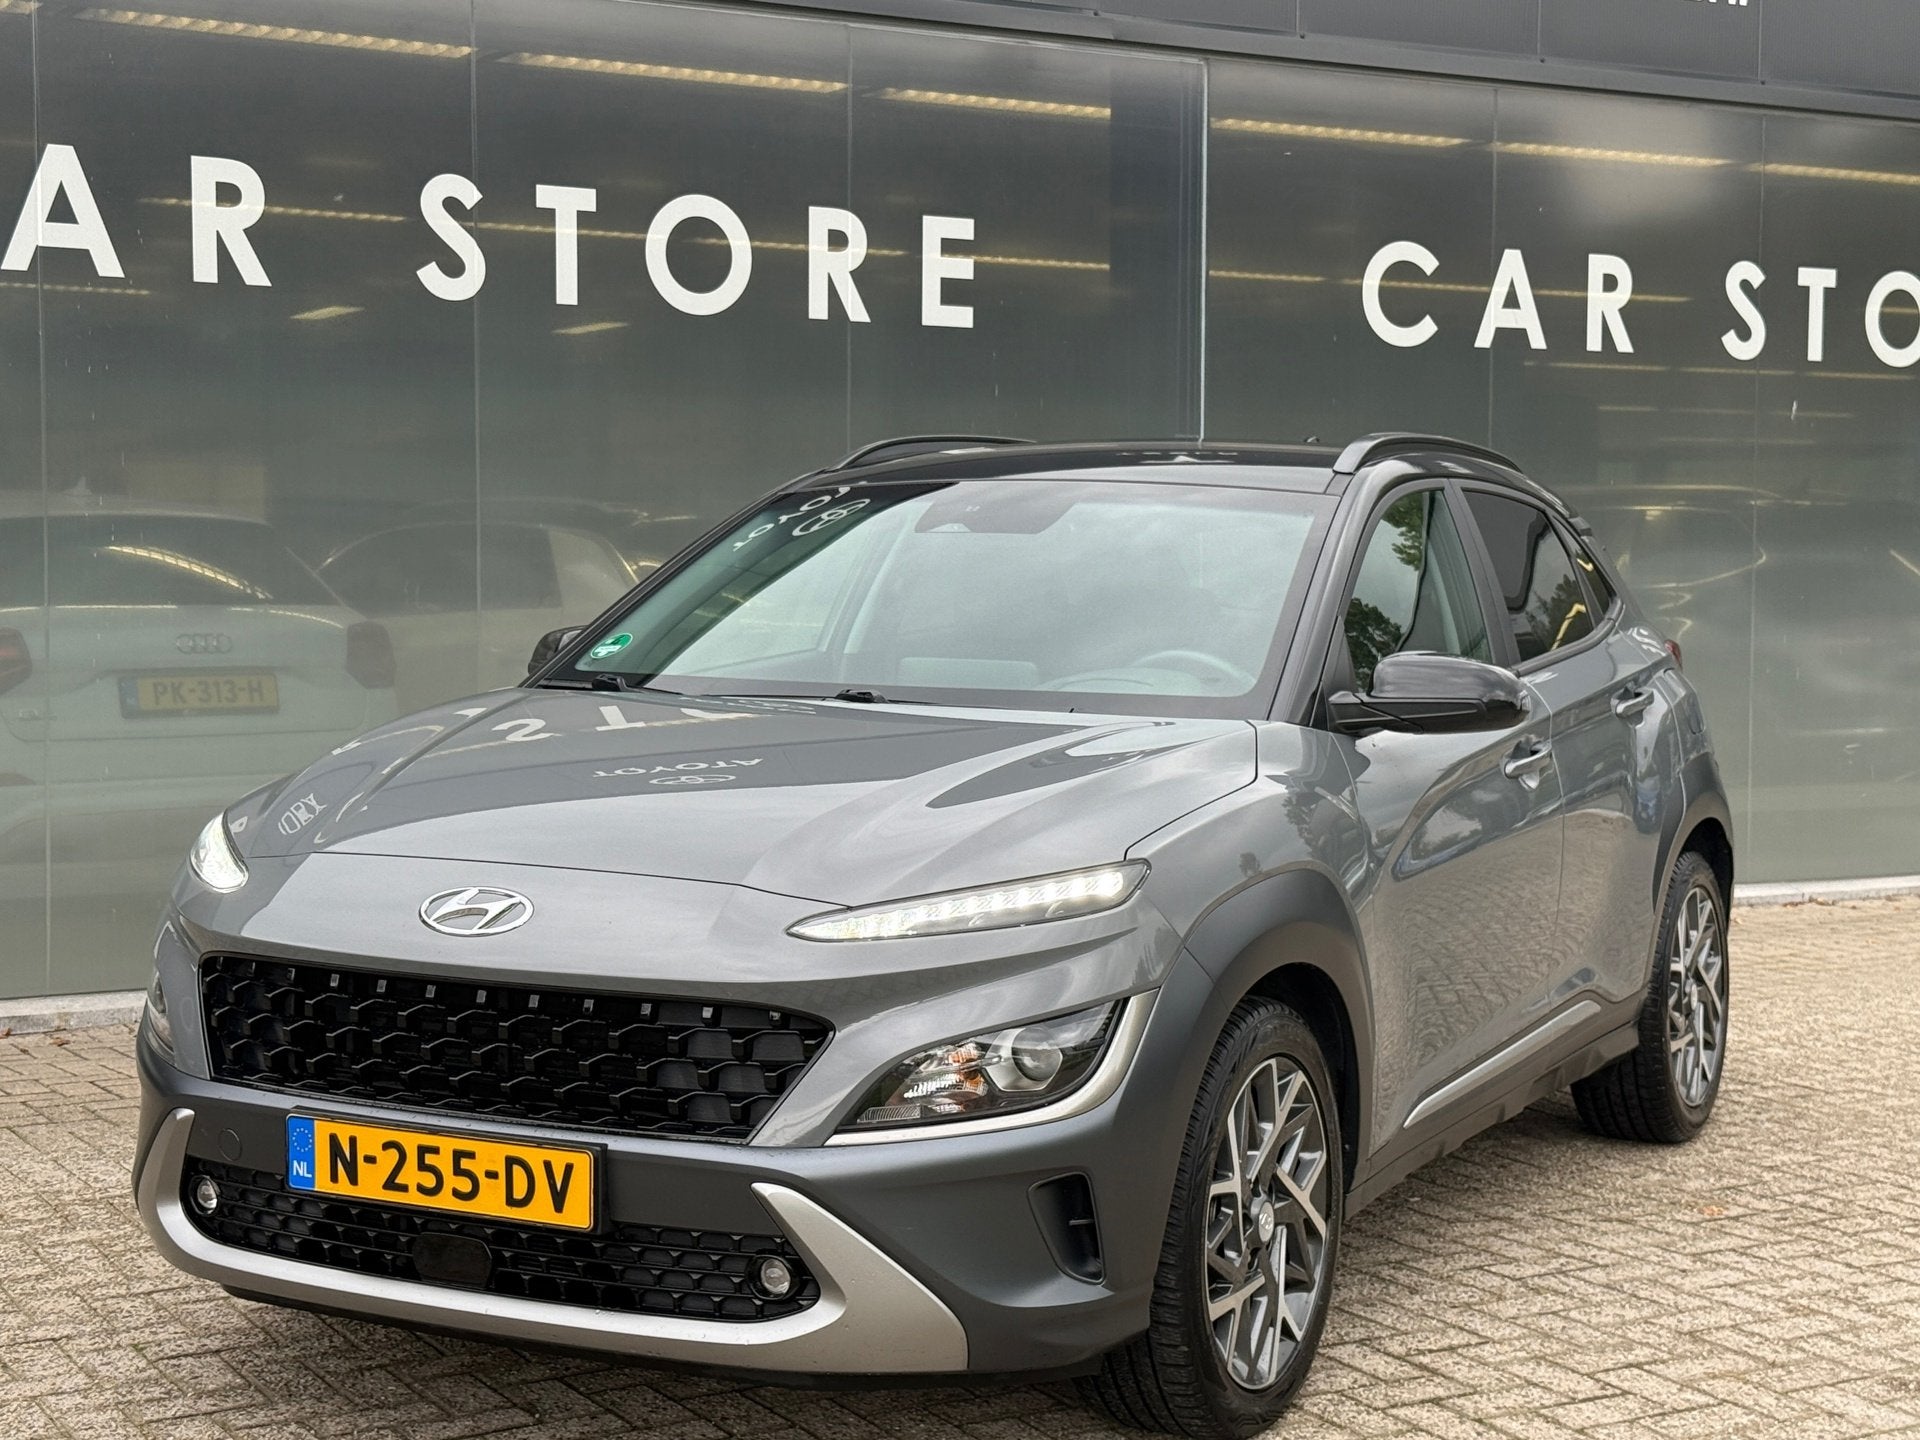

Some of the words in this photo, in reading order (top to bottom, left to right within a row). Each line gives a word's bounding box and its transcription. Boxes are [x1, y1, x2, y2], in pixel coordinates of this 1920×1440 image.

[416, 173, 975, 328] STORE
[1362, 240, 1635, 353] CAR
[1721, 260, 1920, 368] STO
[152, 679, 264, 705] PK-313-H
[292, 1160, 313, 1178] NL
[328, 1132, 575, 1214] N-255-DV
